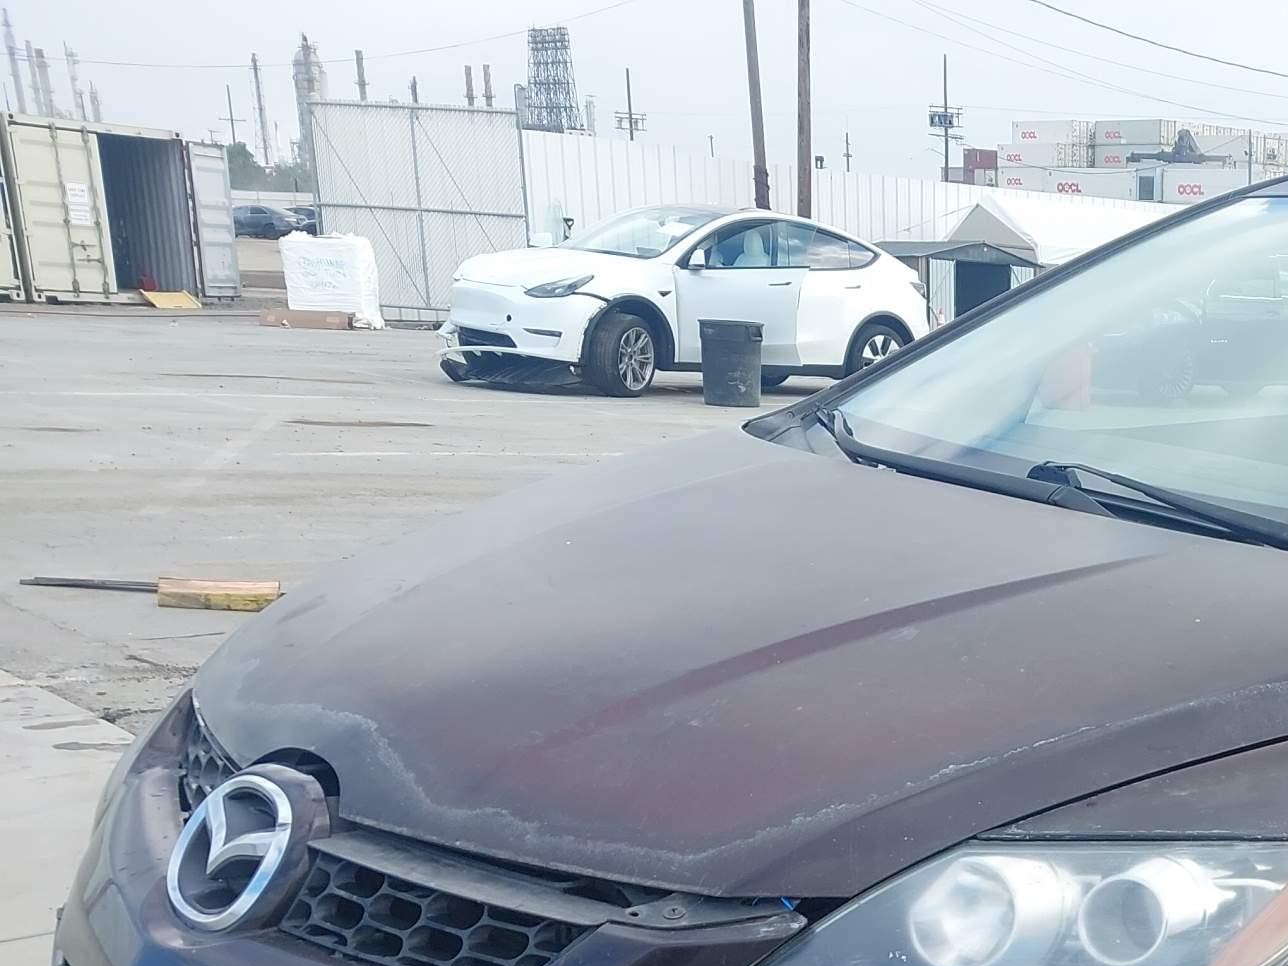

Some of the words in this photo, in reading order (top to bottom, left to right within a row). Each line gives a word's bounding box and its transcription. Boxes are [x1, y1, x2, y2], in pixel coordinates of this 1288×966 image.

[1021, 131, 1037, 139] OOCL
[1006, 154, 1022, 162] OOCL
[1104, 155, 1121, 163] OOCL
[1007, 178, 1023, 186] OOCL
[1057, 183, 1082, 193] OOCL
[1178, 184, 1205, 195] OOCL
